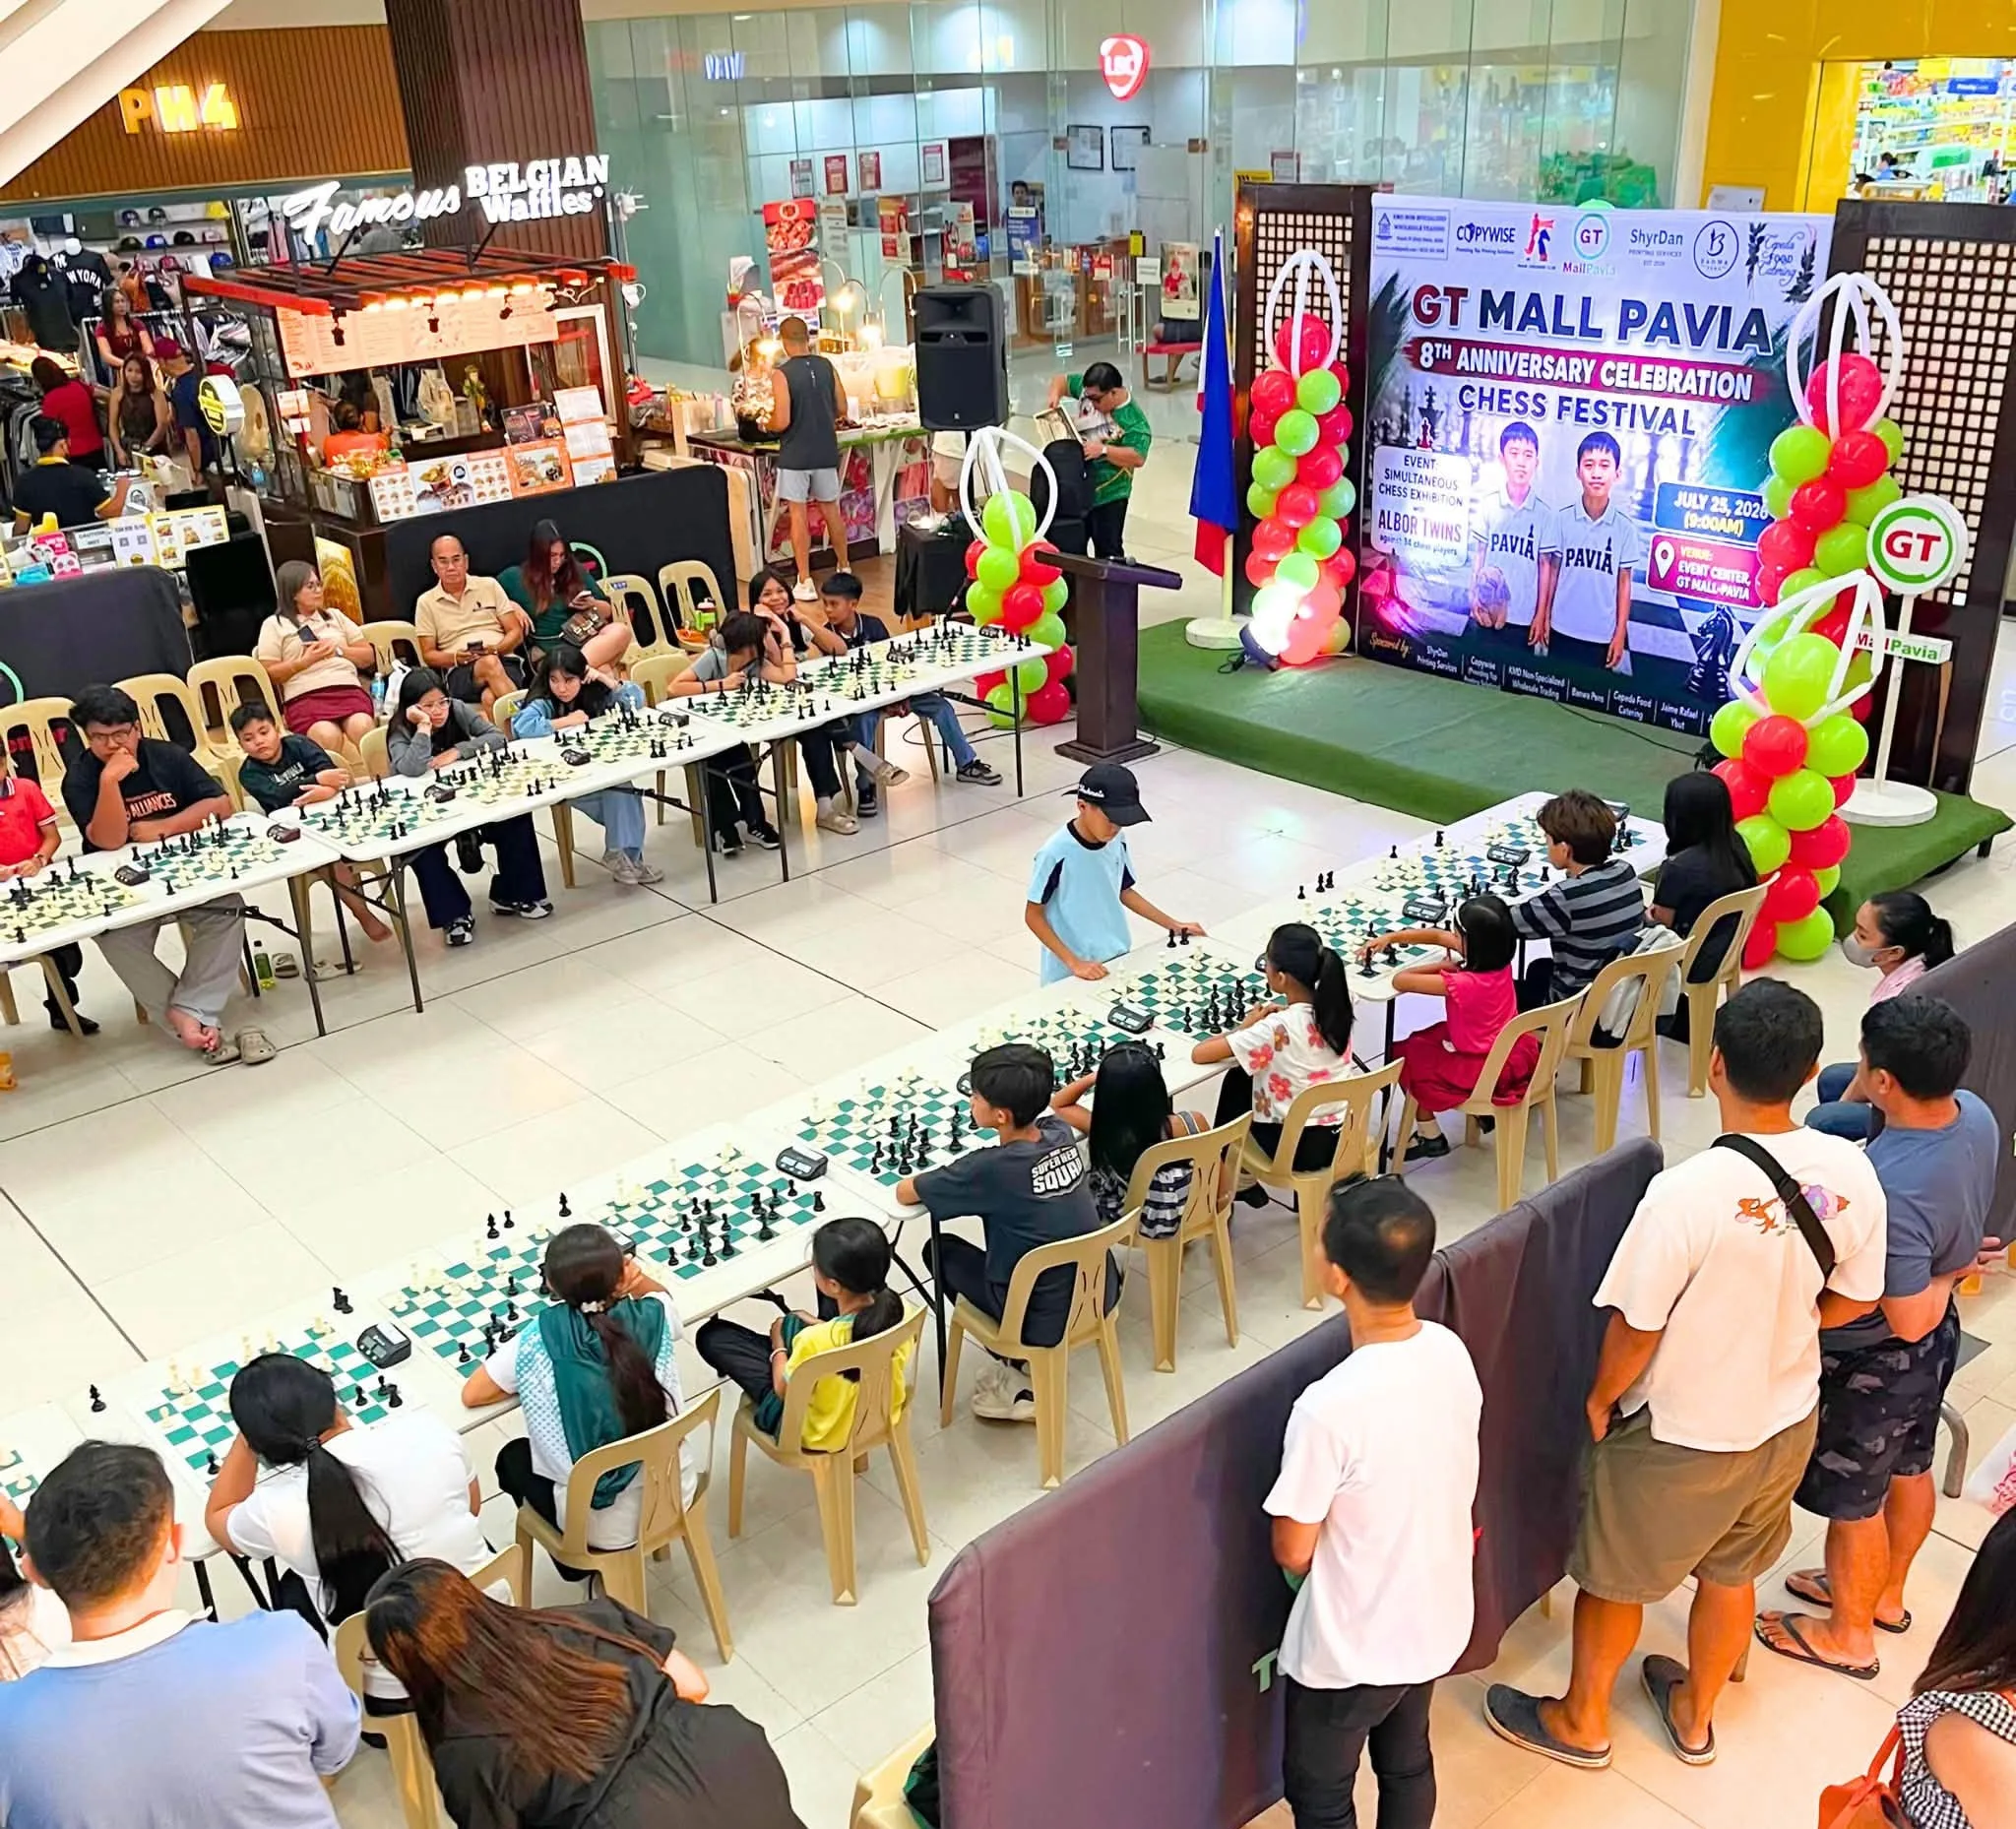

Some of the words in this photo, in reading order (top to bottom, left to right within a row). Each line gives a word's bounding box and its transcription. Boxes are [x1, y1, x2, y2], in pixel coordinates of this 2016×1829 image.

[465, 155, 609, 198] BELGIAN
[282, 181, 461, 245] Famous
[1457, 222, 1516, 243] COPYWISE
[1580, 228, 1603, 245] GT
[1630, 228, 1683, 248] ShyrDan
[1412, 284, 1469, 329] GT
[1479, 288, 1604, 340] MALL
[1617, 298, 1774, 355] PAVIA
[1419, 342, 1452, 370] 8TH
[1456, 347, 1595, 385] ANNIVERSARY
[1600, 361, 1753, 402] CELEBRATION
[1458, 384, 1546, 419] CHESS
[1556, 397, 1696, 436] FESTIVAL
[1384, 468, 1459, 491] SIMULTANEOUS
[1378, 482, 1408, 499] CHESS
[1410, 488, 1463, 507] EXHIBITION
[1673, 490, 1709, 511] JULY
[1733, 499, 1769, 521] 2026
[1378, 509, 1418, 535] ALBOR
[1423, 518, 1462, 543] TWINS
[1490, 533, 1536, 562] PAVIA
[1884, 530, 1942, 563] GT
[1565, 547, 1613, 576] PAVIA
[1678, 559, 1710, 577] EVENT
[1675, 574, 1691, 589] GT
[1855, 633, 1939, 661] MlPavia
[129, 792, 177, 818] ALLIANCES
[1031, 1155, 1062, 1179] SUPER
